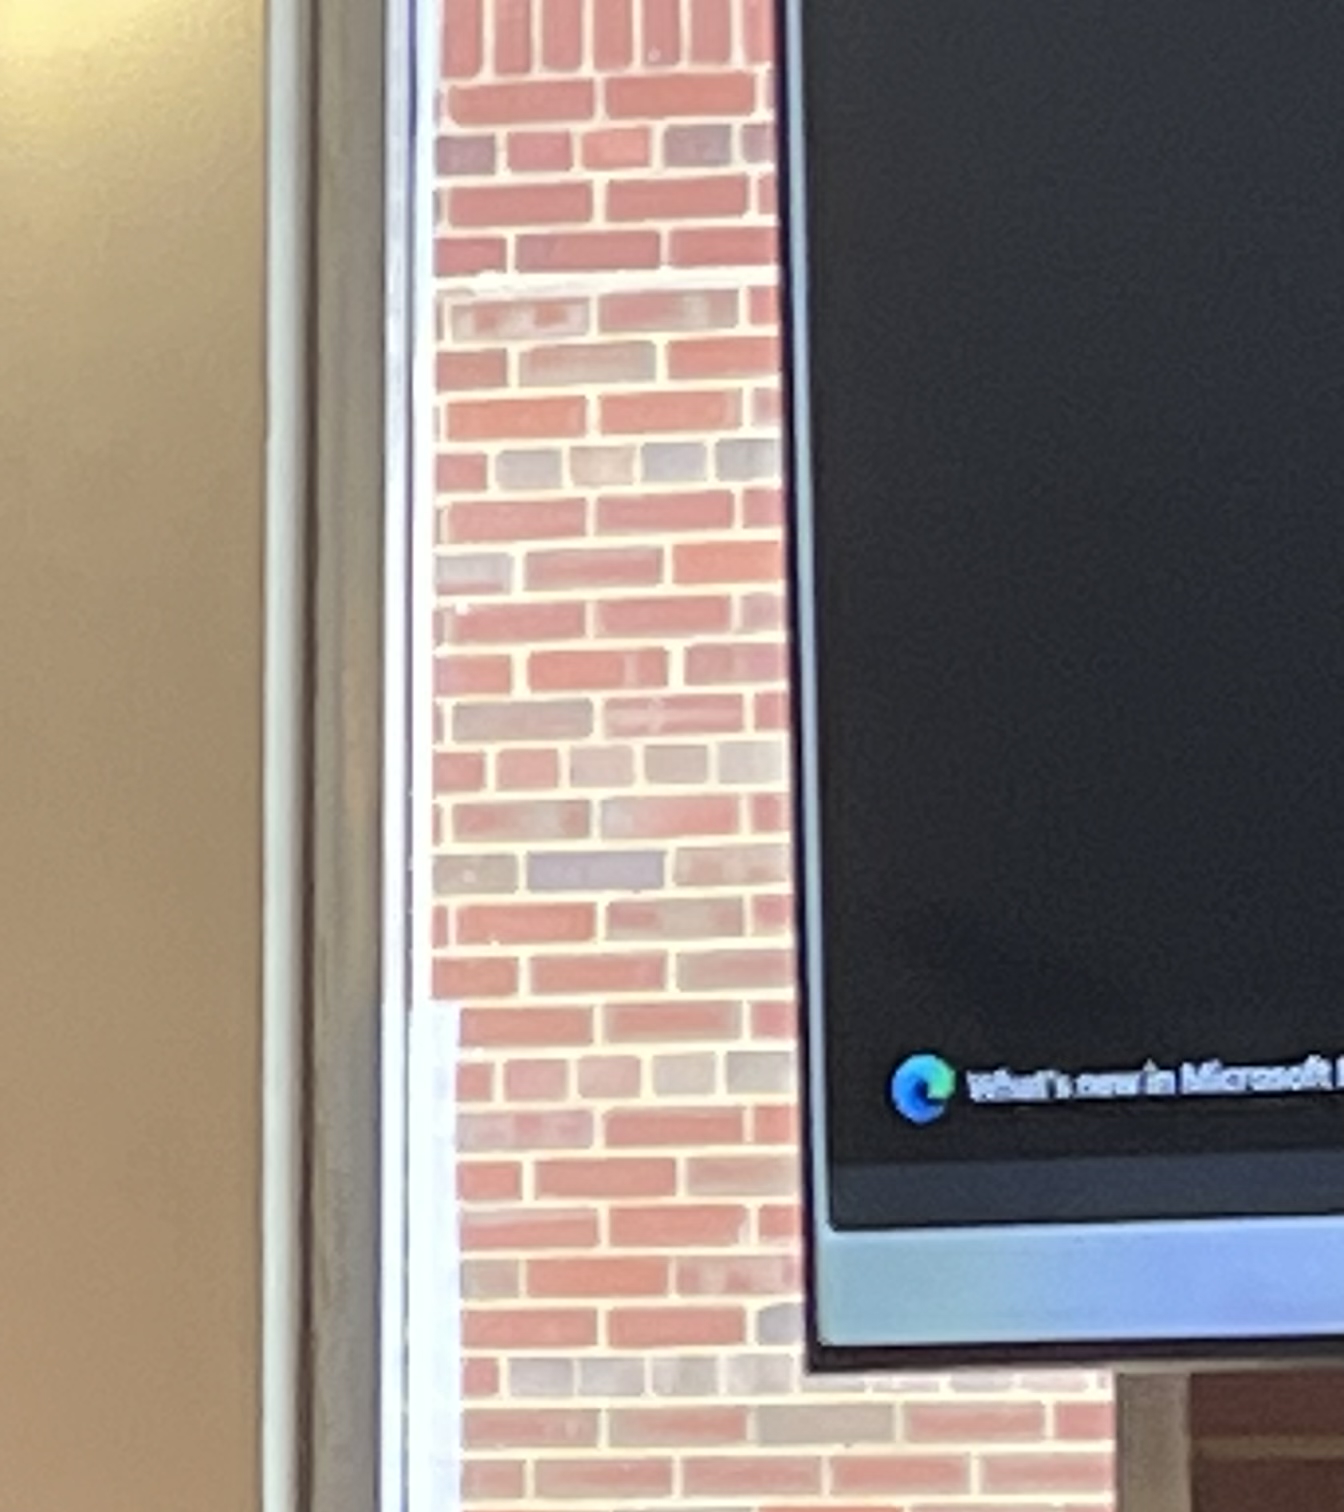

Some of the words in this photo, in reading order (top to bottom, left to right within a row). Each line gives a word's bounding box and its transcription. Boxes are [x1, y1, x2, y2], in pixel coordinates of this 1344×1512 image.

[966, 1066, 1072, 1103] What's
[1143, 1058, 1176, 1096] in
[1180, 1054, 1334, 1095] Microsoft
